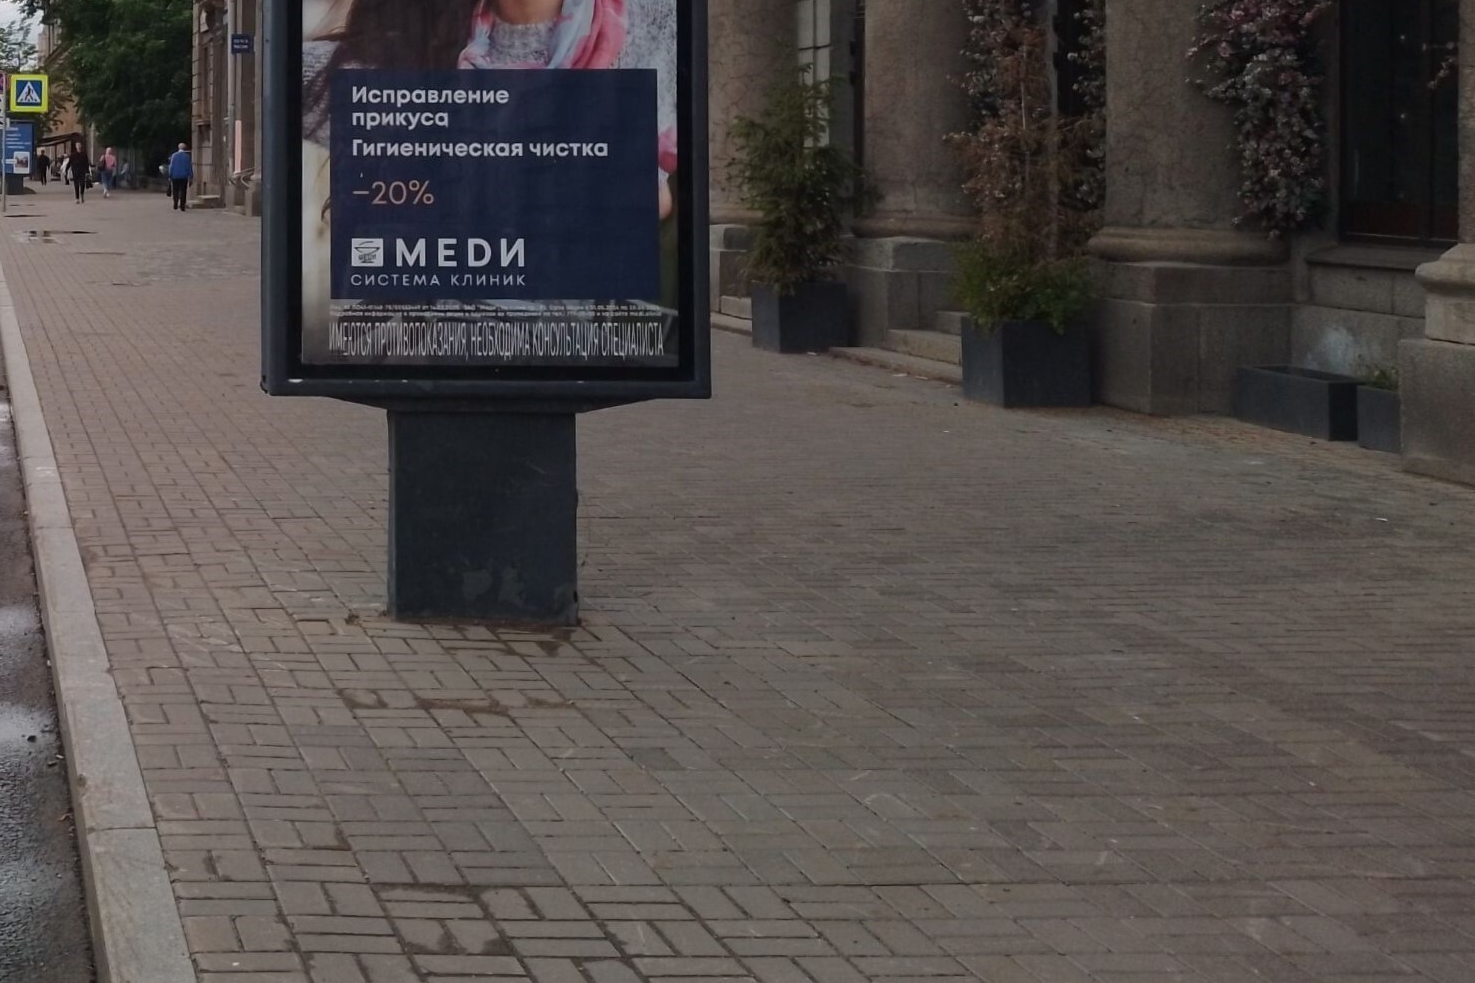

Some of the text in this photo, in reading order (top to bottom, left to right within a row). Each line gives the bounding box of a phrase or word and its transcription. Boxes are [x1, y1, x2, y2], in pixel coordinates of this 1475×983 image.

[351, 85, 510, 107] Исправление
[351, 112, 449, 130] прикуса
[351, 139, 609, 157] Гигиеническая чистка
[350, 274, 526, 286] СИСТЕМА КЛИНИК
[329, 322, 664, 361] ИМЕЮТСЯ ПРОТИВОПОКАЗАНИЯ, НЕОБХОДИМА КОНСУЛЬТАЦИЯ СПЕЦИАЛИСТА
